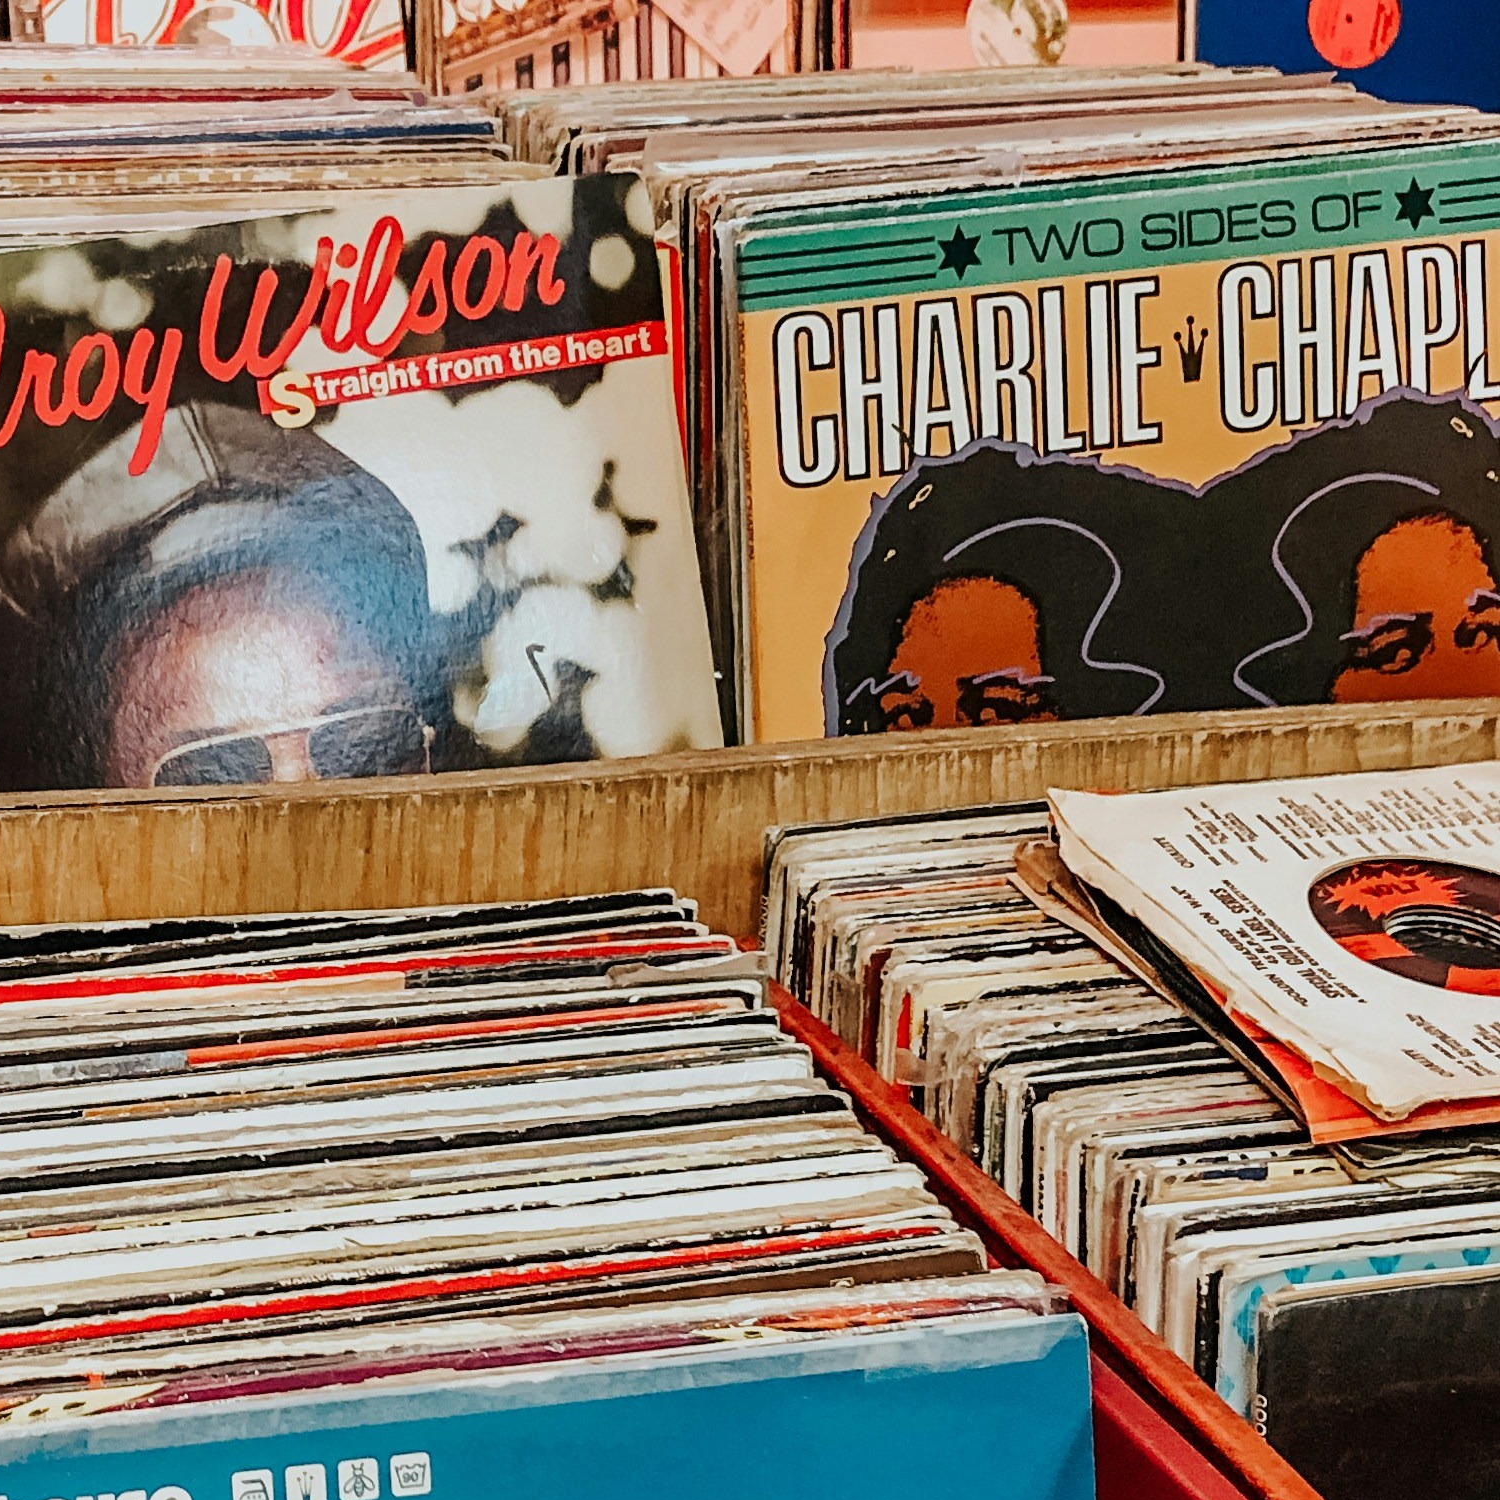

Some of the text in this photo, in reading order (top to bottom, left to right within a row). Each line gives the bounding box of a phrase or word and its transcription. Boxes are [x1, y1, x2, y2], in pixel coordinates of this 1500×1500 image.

[992, 189, 1383, 267] TWO SIDES OF
[198, 216, 565, 381] Wilson
[269, 324, 652, 429] Straight from the heart
[772, 275, 1164, 490] CHARLIE
